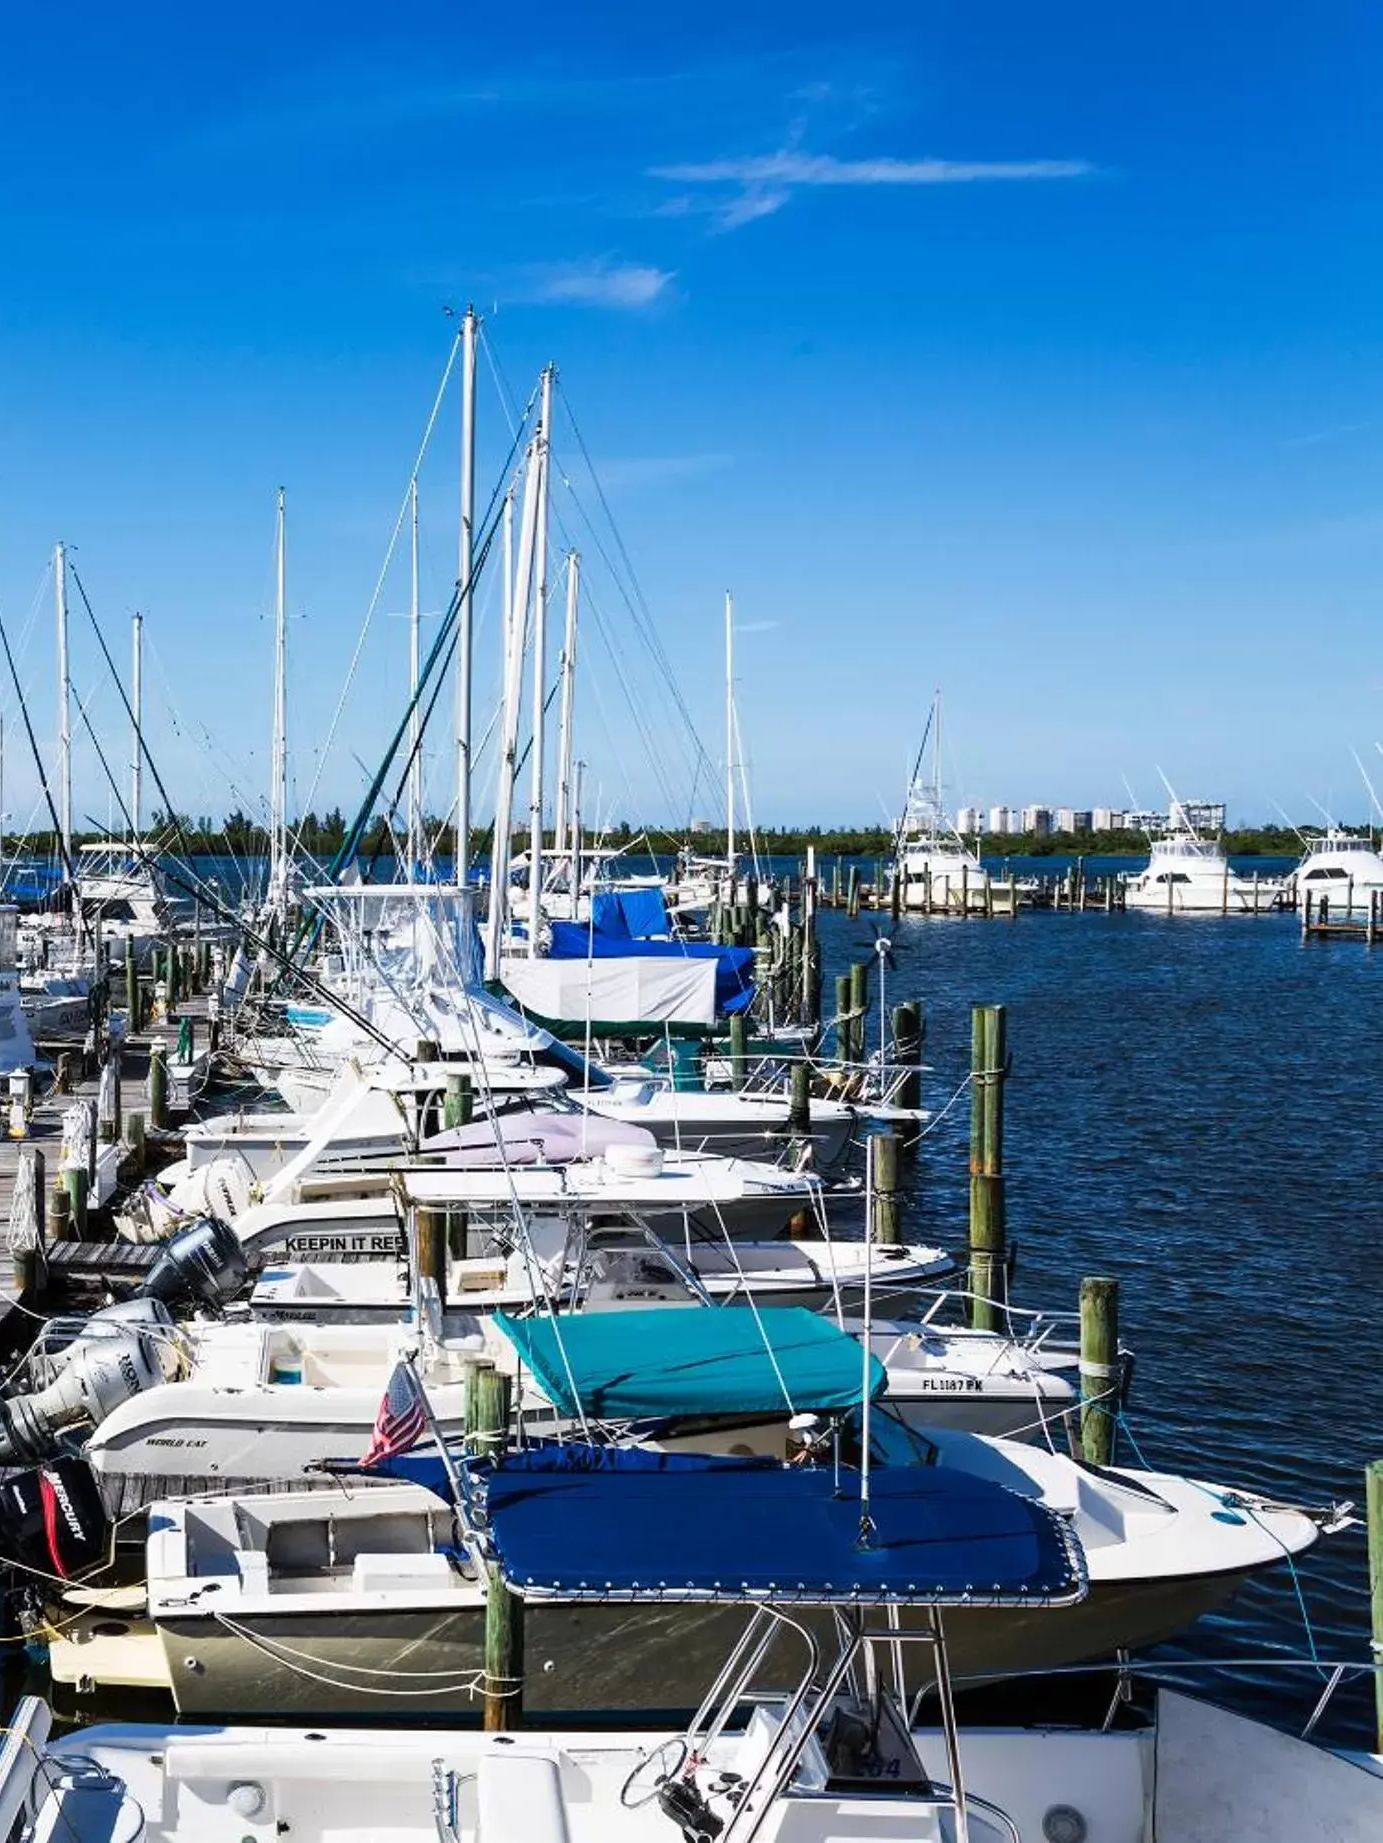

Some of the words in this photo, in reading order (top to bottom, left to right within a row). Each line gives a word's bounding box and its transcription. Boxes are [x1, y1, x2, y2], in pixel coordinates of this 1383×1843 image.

[285, 1237, 346, 1251] KEEPIN
[352, 1237, 366, 1250] IT
[146, 1439, 184, 1448] WORLD
[186, 1440, 208, 1449] CAT
[42, 1470, 86, 1541] MERCURY
